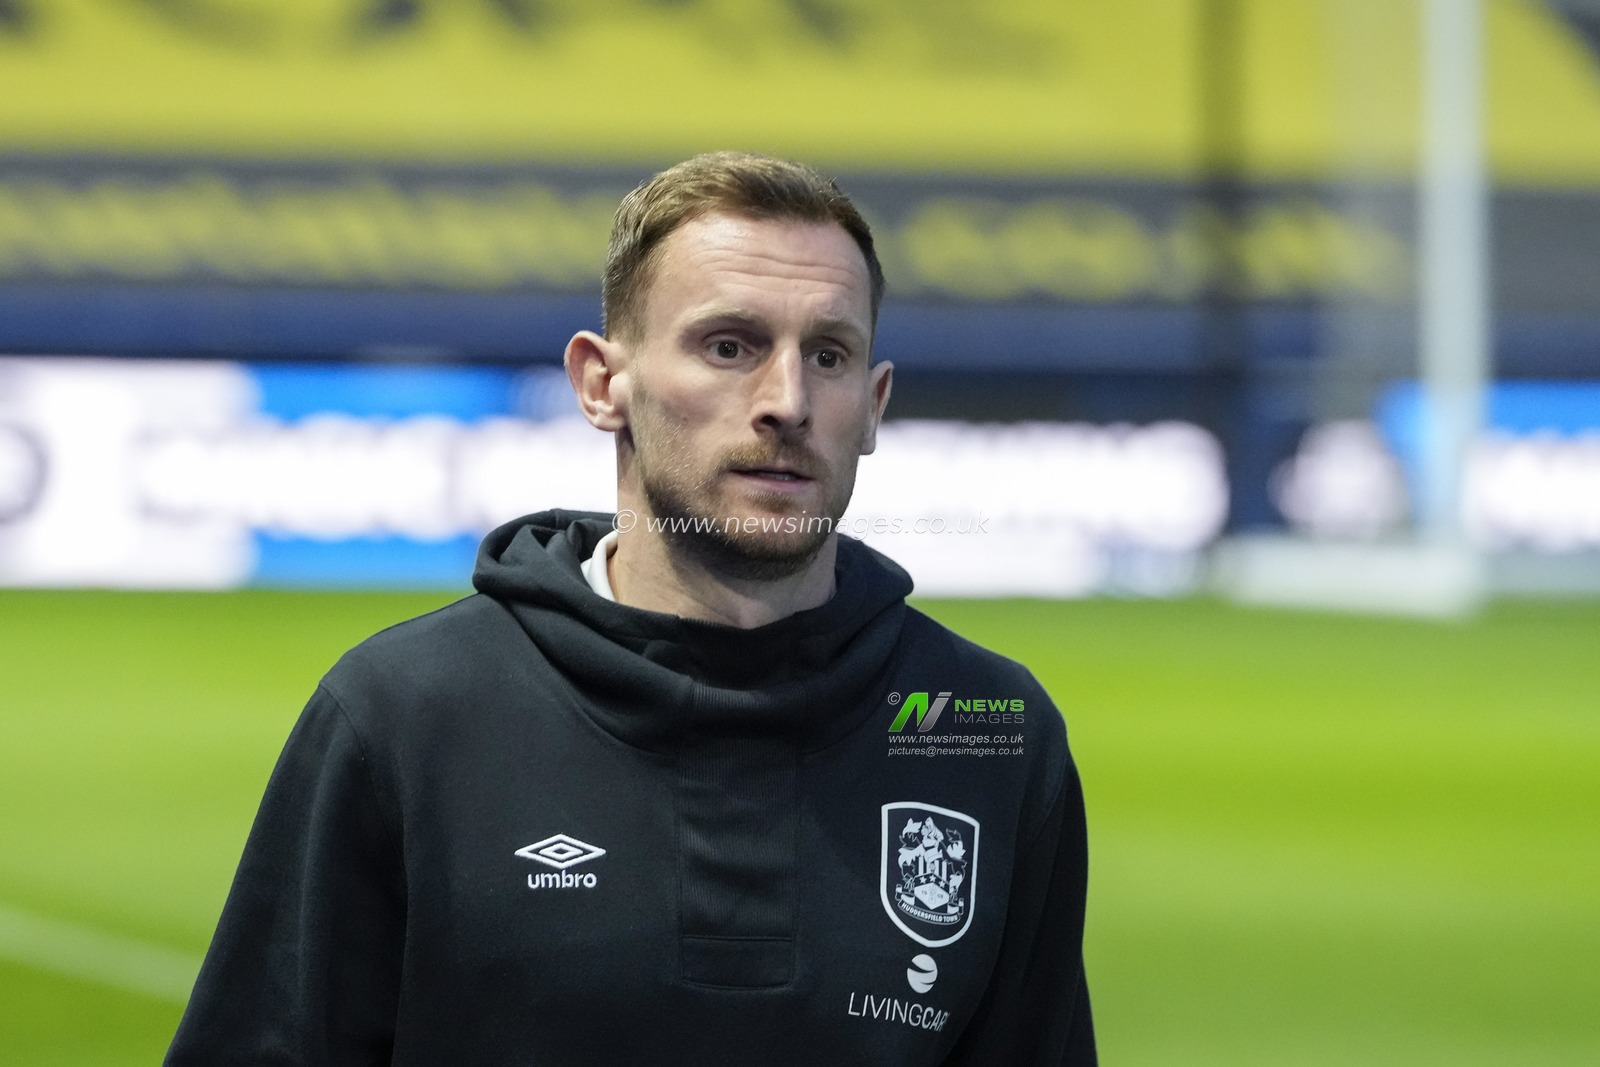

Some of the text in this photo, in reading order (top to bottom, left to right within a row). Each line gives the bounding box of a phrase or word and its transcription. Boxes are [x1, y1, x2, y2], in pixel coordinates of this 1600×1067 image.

[527, 869, 597, 889] umbro
[901, 902, 943, 922] HUDDERSFIELD
[848, 992, 951, 1032] LIVINGCAR
